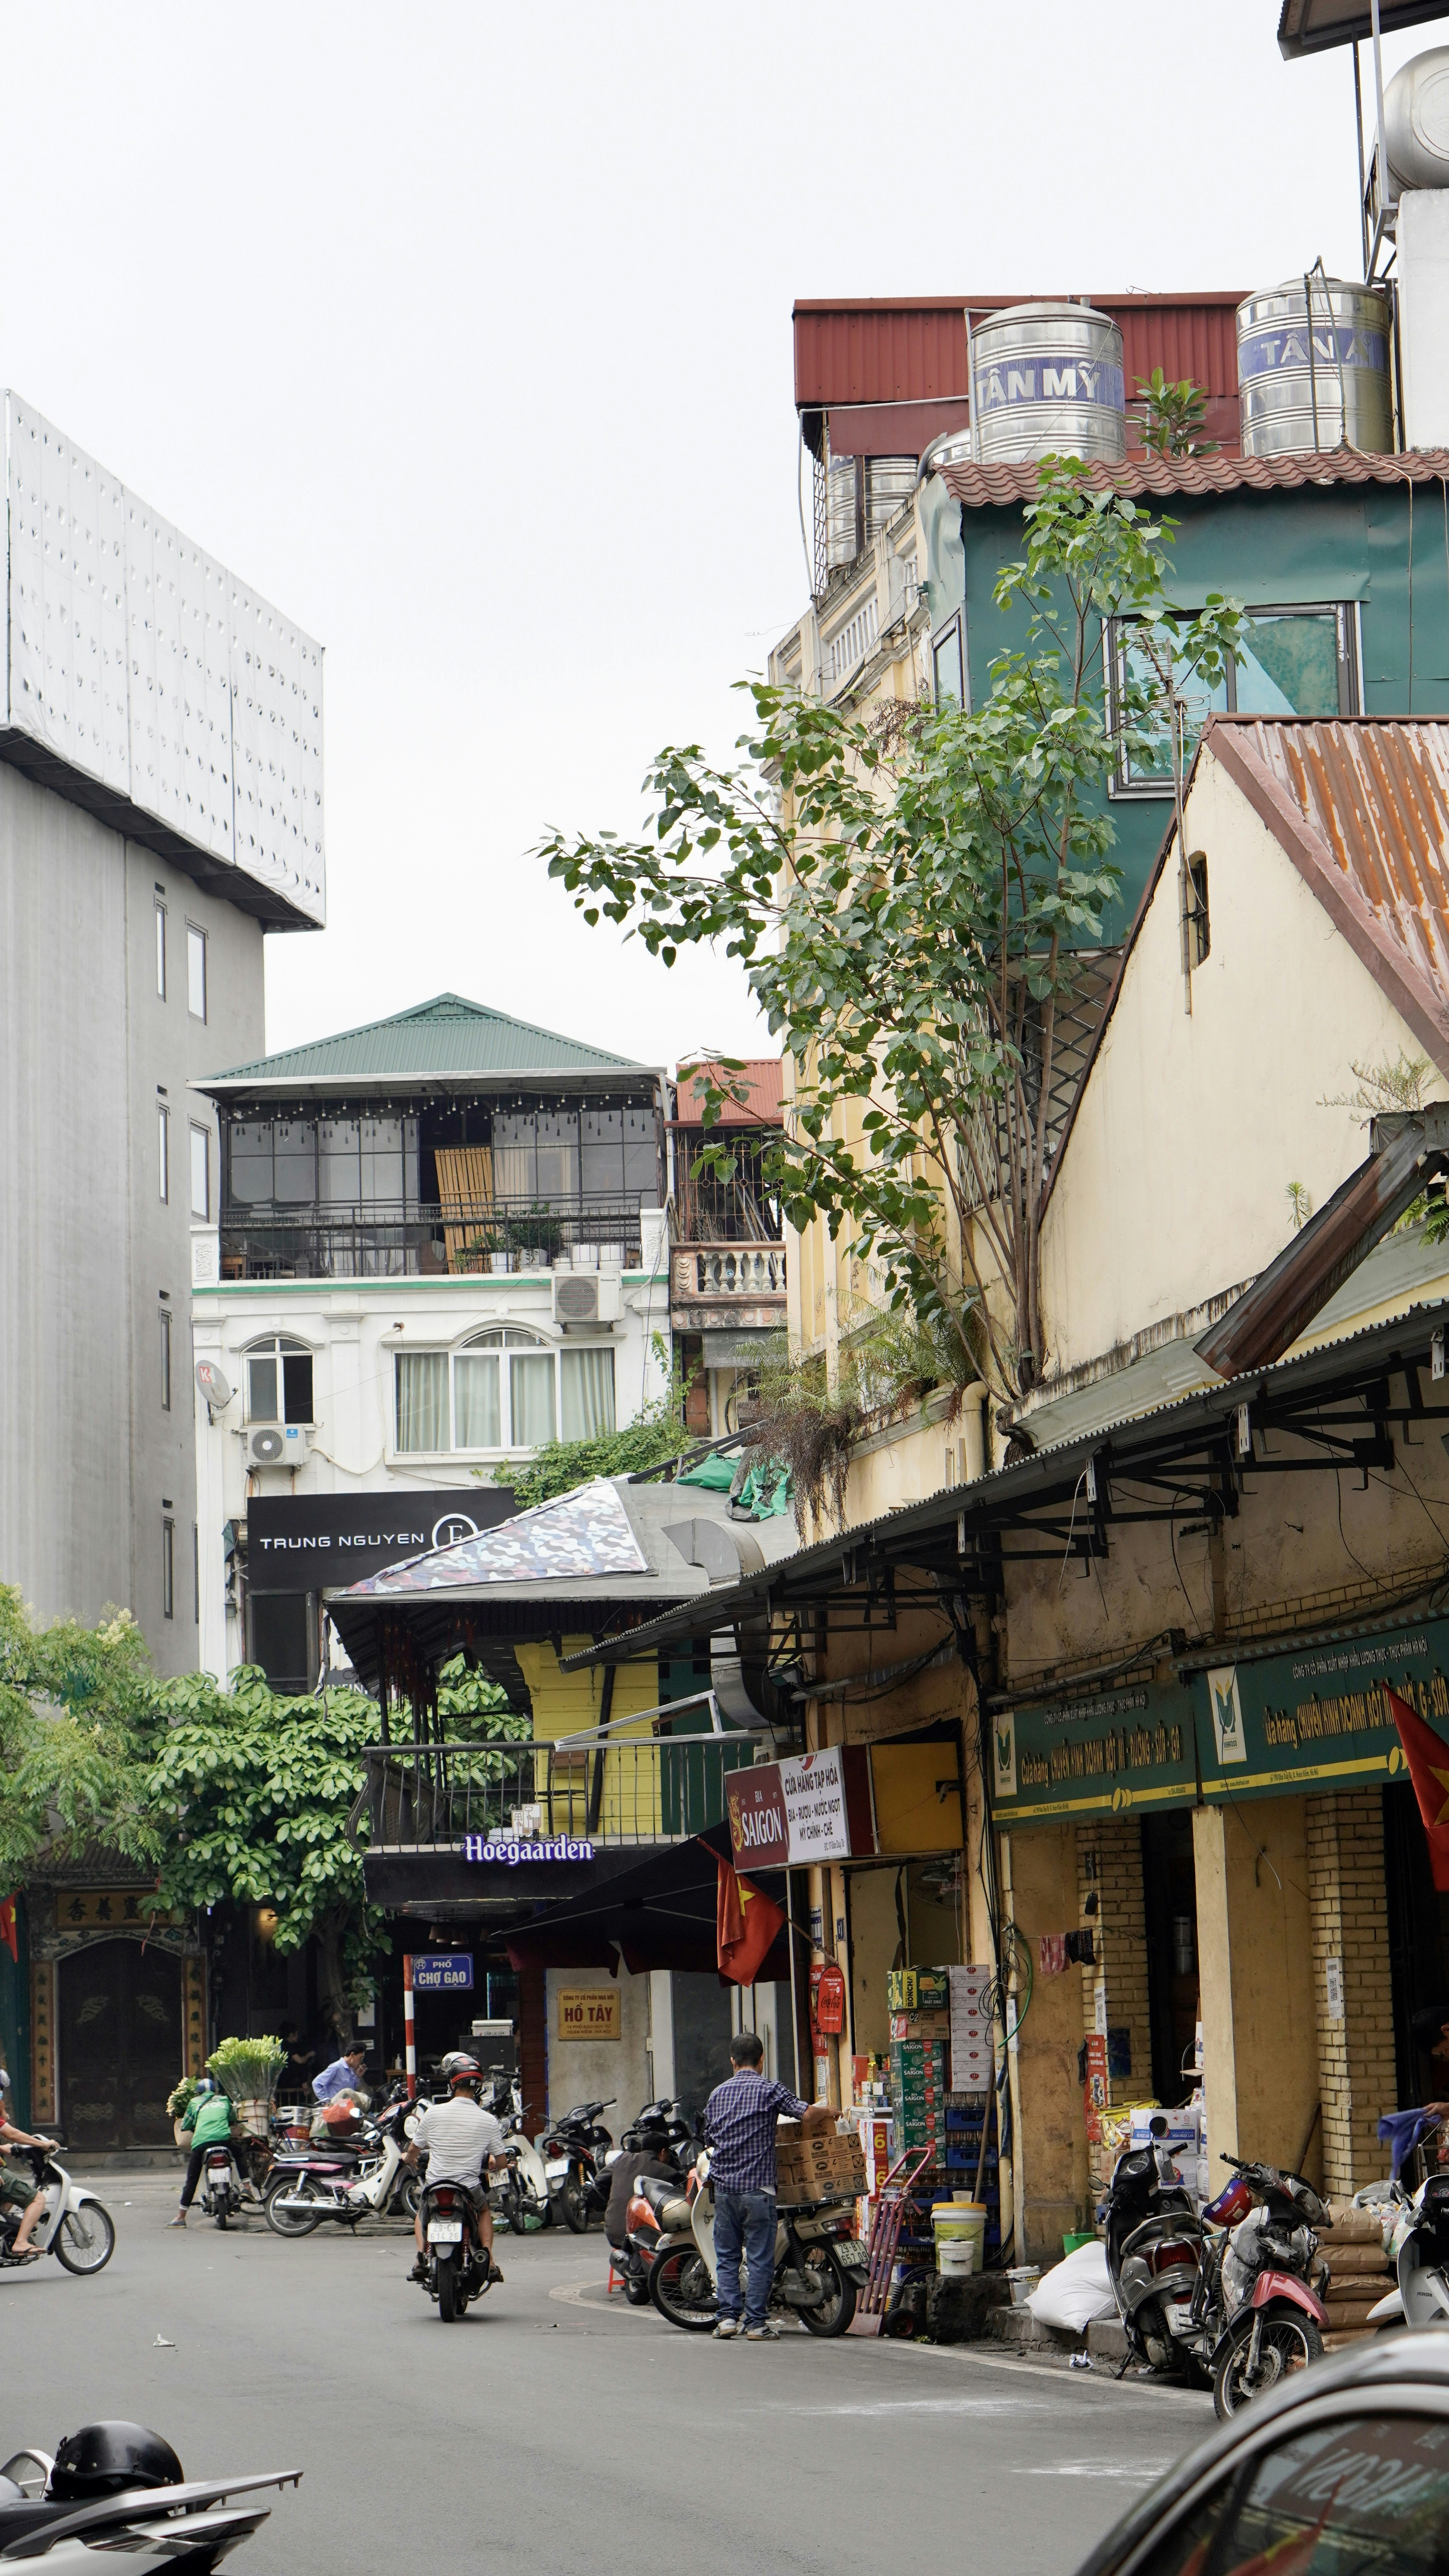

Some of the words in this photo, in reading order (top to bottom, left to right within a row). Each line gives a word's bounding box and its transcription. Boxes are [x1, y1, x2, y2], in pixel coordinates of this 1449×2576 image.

[1261, 332, 1334, 365] TÂN
[976, 368, 1034, 408] TÂN
[1043, 361, 1101, 399] MỸ
[260, 1536, 330, 1549] TRUNG
[338, 1533, 424, 1546] NGUYEN
[1293, 1663, 1305, 1679] CÔNG
[1305, 1664, 1310, 1677] TY
[1310, 1655, 1316, 1675] CỔ
[1328, 1652, 1338, 1672] XUẤT
[1337, 1653, 1349, 1673] NHẬP
[1349, 1646, 1360, 1668] KHẨU
[1360, 1650, 1376, 1665] LƯƠNG
[1375, 1647, 1387, 1666] THỰC
[1389, 1644, 1401, 1663] THỰC
[1400, 1634, 1413, 1657] PHẨM
[1412, 1637, 1419, 1655] HÀ
[1418, 1635, 1428, 1657] NỘI
[1275, 1710, 1299, 1750] hàng
[1297, 1693, 1324, 1740] CHUYÊN
[1322, 1698, 1342, 1735] KINH
[1339, 1693, 1368, 1733] DOANH
[1034, 1753, 1050, 1788] hàng
[1052, 1738, 1071, 1780] CHUYÊN
[1071, 1744, 1084, 1777] KINH
[1085, 1740, 1104, 1775] DOANH
[1106, 1729, 1116, 1778] BỘT
[785, 1773, 797, 1796] CỬA
[797, 1770, 814, 1794] HÀNG
[814, 1769, 825, 1795] TẠP
[825, 1762, 839, 1787] HÓA
[755, 1790, 763, 1803] BIA
[798, 1804, 811, 1824] RƯỢU
[814, 1798, 828, 1817] NƯỚC
[828, 1798, 840, 1817] NGỌT
[742, 1806, 782, 1846] SAIGON
[806, 1821, 821, 1840] CHÍNH
[824, 1818, 833, 1836] CHÈ
[465, 1834, 593, 1865] Hoegaarden
[433, 1958, 452, 1968] PHỐ
[418, 1971, 442, 1987] CHỢ
[444, 1971, 466, 1986] GẠO
[564, 2002, 583, 2022] HỒ
[587, 2004, 613, 2022] TÂY
[874, 2133, 885, 2149] 6
[876, 2171, 887, 2186] 6
[430, 2233, 459, 2241] 614.26
[433, 2224, 456, 2233] 29-C1
[839, 2242, 861, 2254] 29-B1
